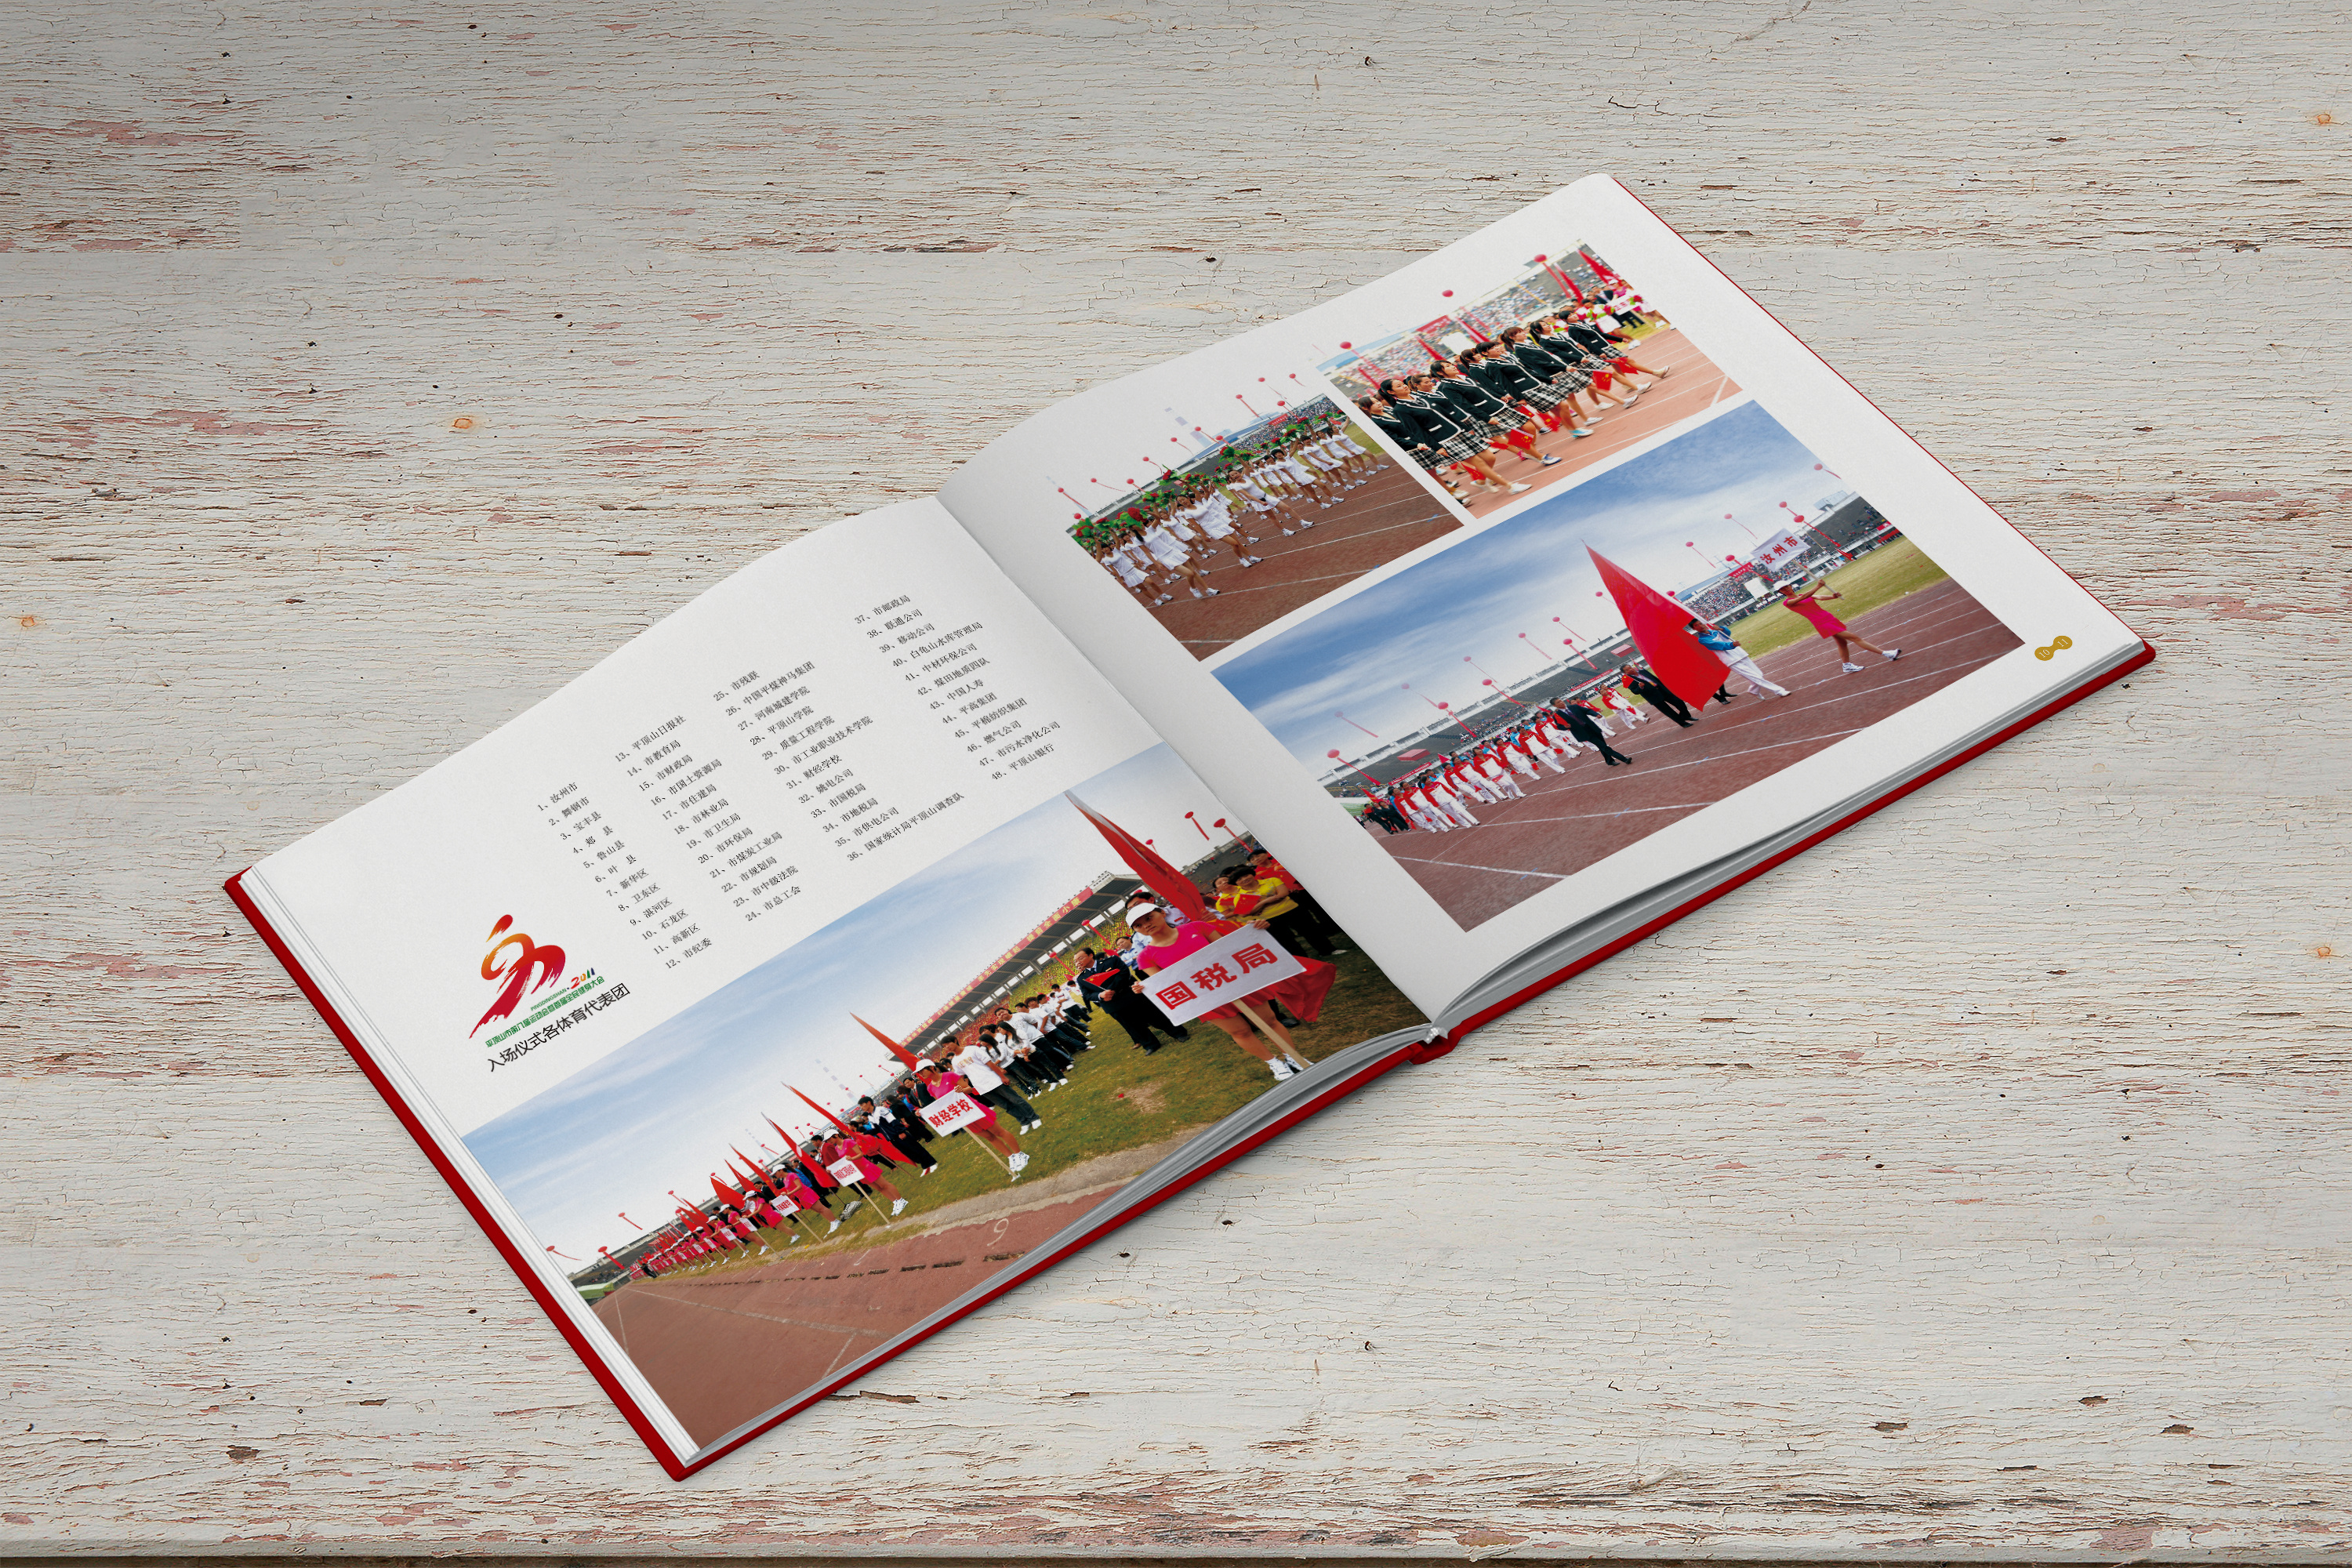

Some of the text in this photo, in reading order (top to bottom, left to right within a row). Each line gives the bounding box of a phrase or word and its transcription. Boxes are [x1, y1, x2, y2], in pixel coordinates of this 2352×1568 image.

[1759, 535, 1798, 564] 汝州市
[2038, 649, 2050, 659] 10
[2057, 638, 2069, 648] 11
[1156, 943, 1278, 1010] 国税局
[488, 982, 630, 1072] 入场仪式各体育代表团
[928, 1099, 973, 1127] 财经学校
